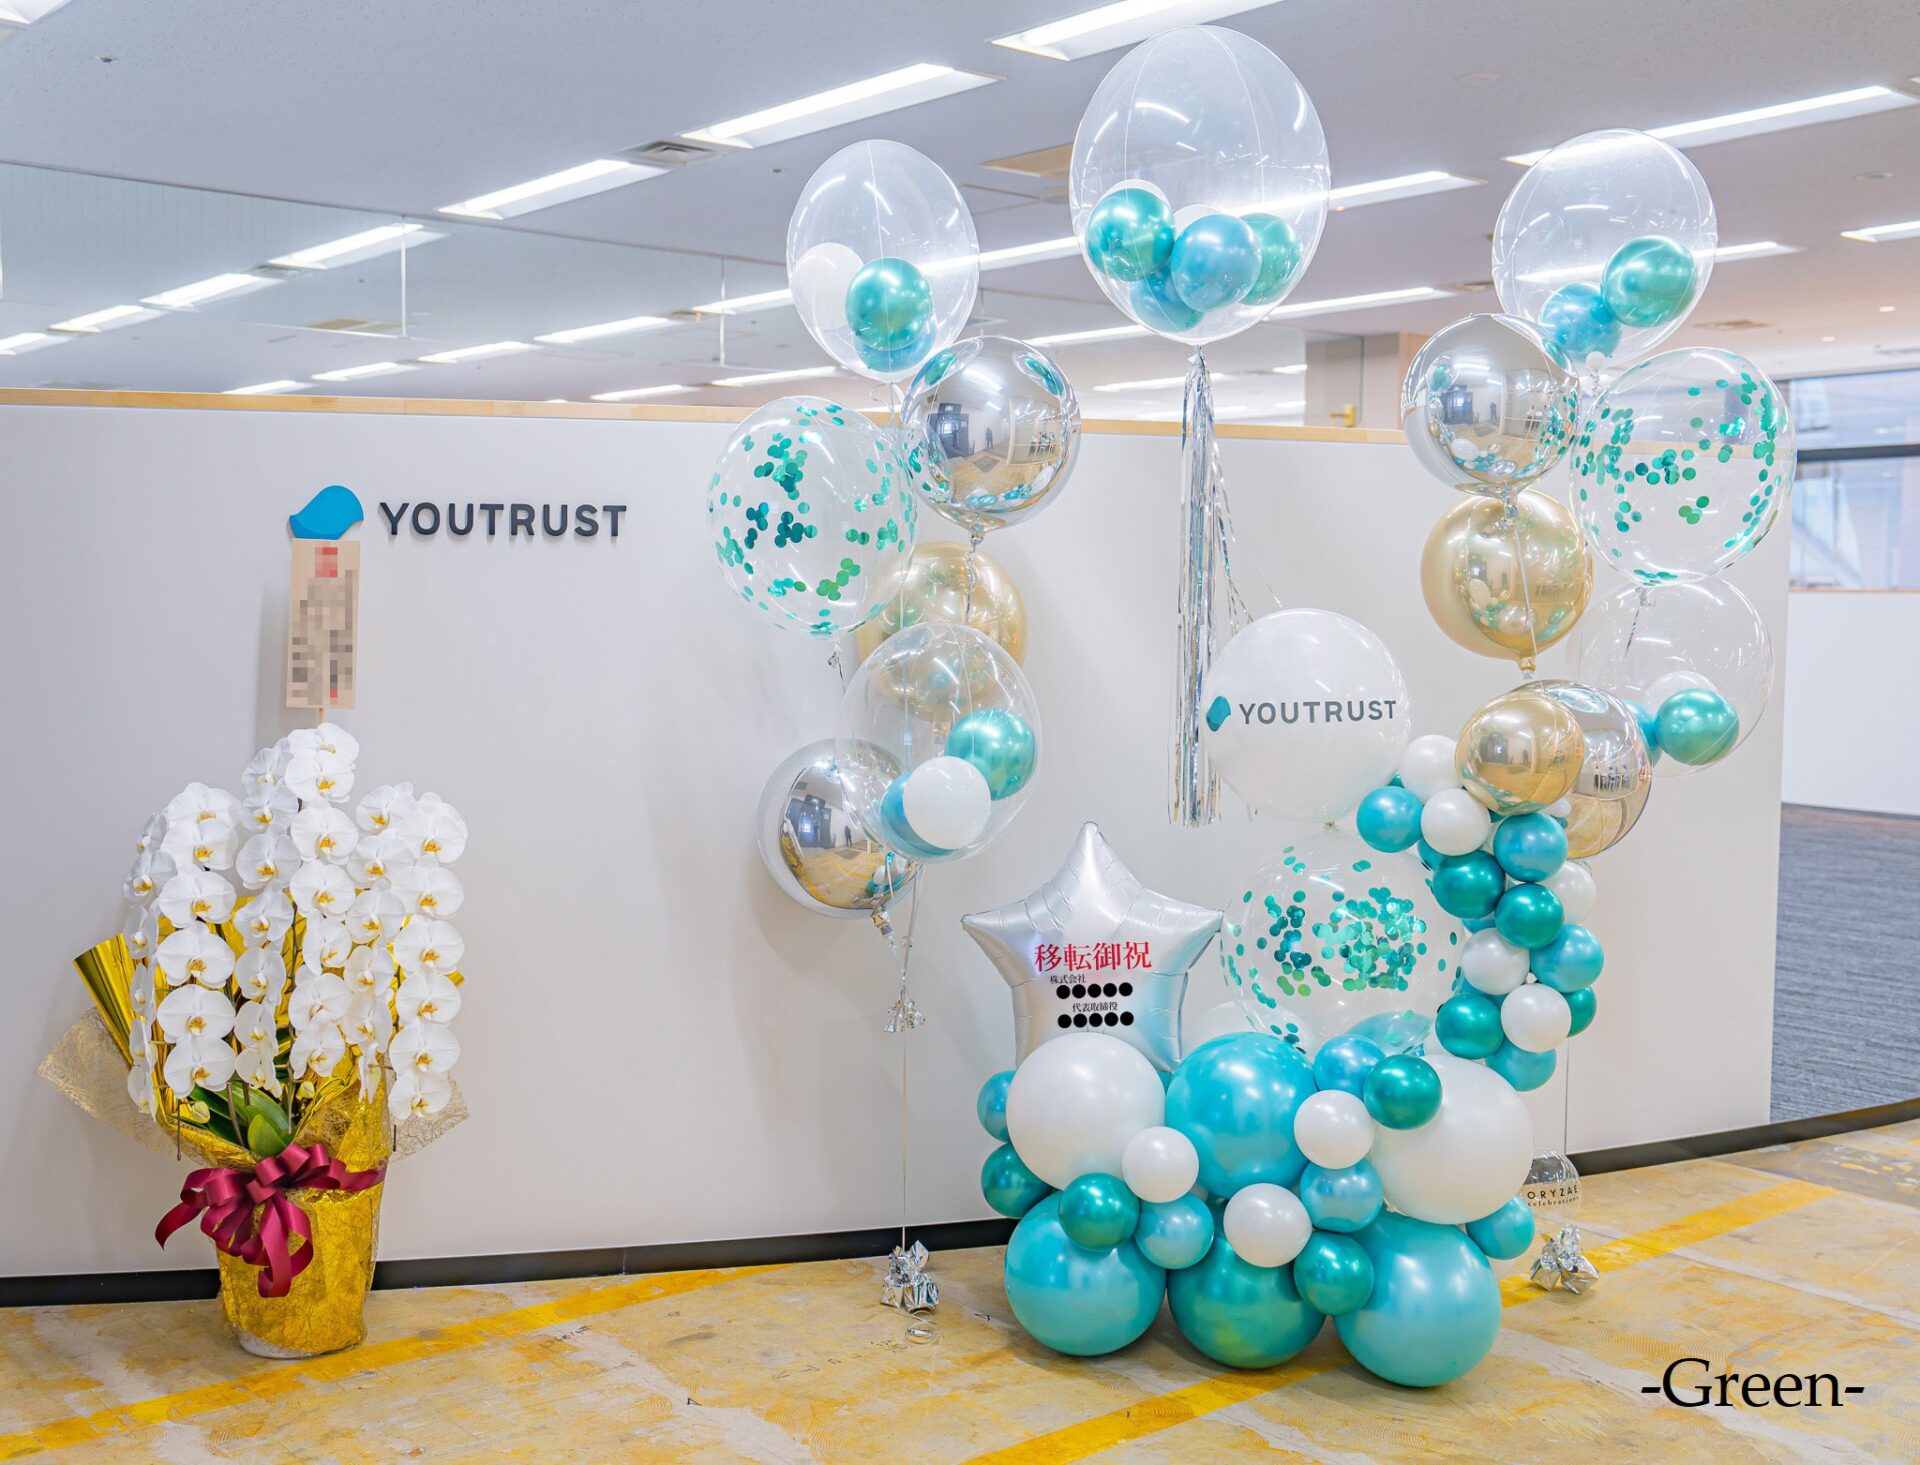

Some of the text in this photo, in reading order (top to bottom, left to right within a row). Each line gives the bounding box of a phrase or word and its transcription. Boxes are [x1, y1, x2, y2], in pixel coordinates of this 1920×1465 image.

[379, 502, 627, 537] YOUTRUST
[1239, 700, 1396, 725] YOUTRUST
[1034, 941, 1152, 972] 移転御祝
[1049, 974, 1087, 984] 株式会社
[1072, 1002, 1118, 1013] 代表取締役
